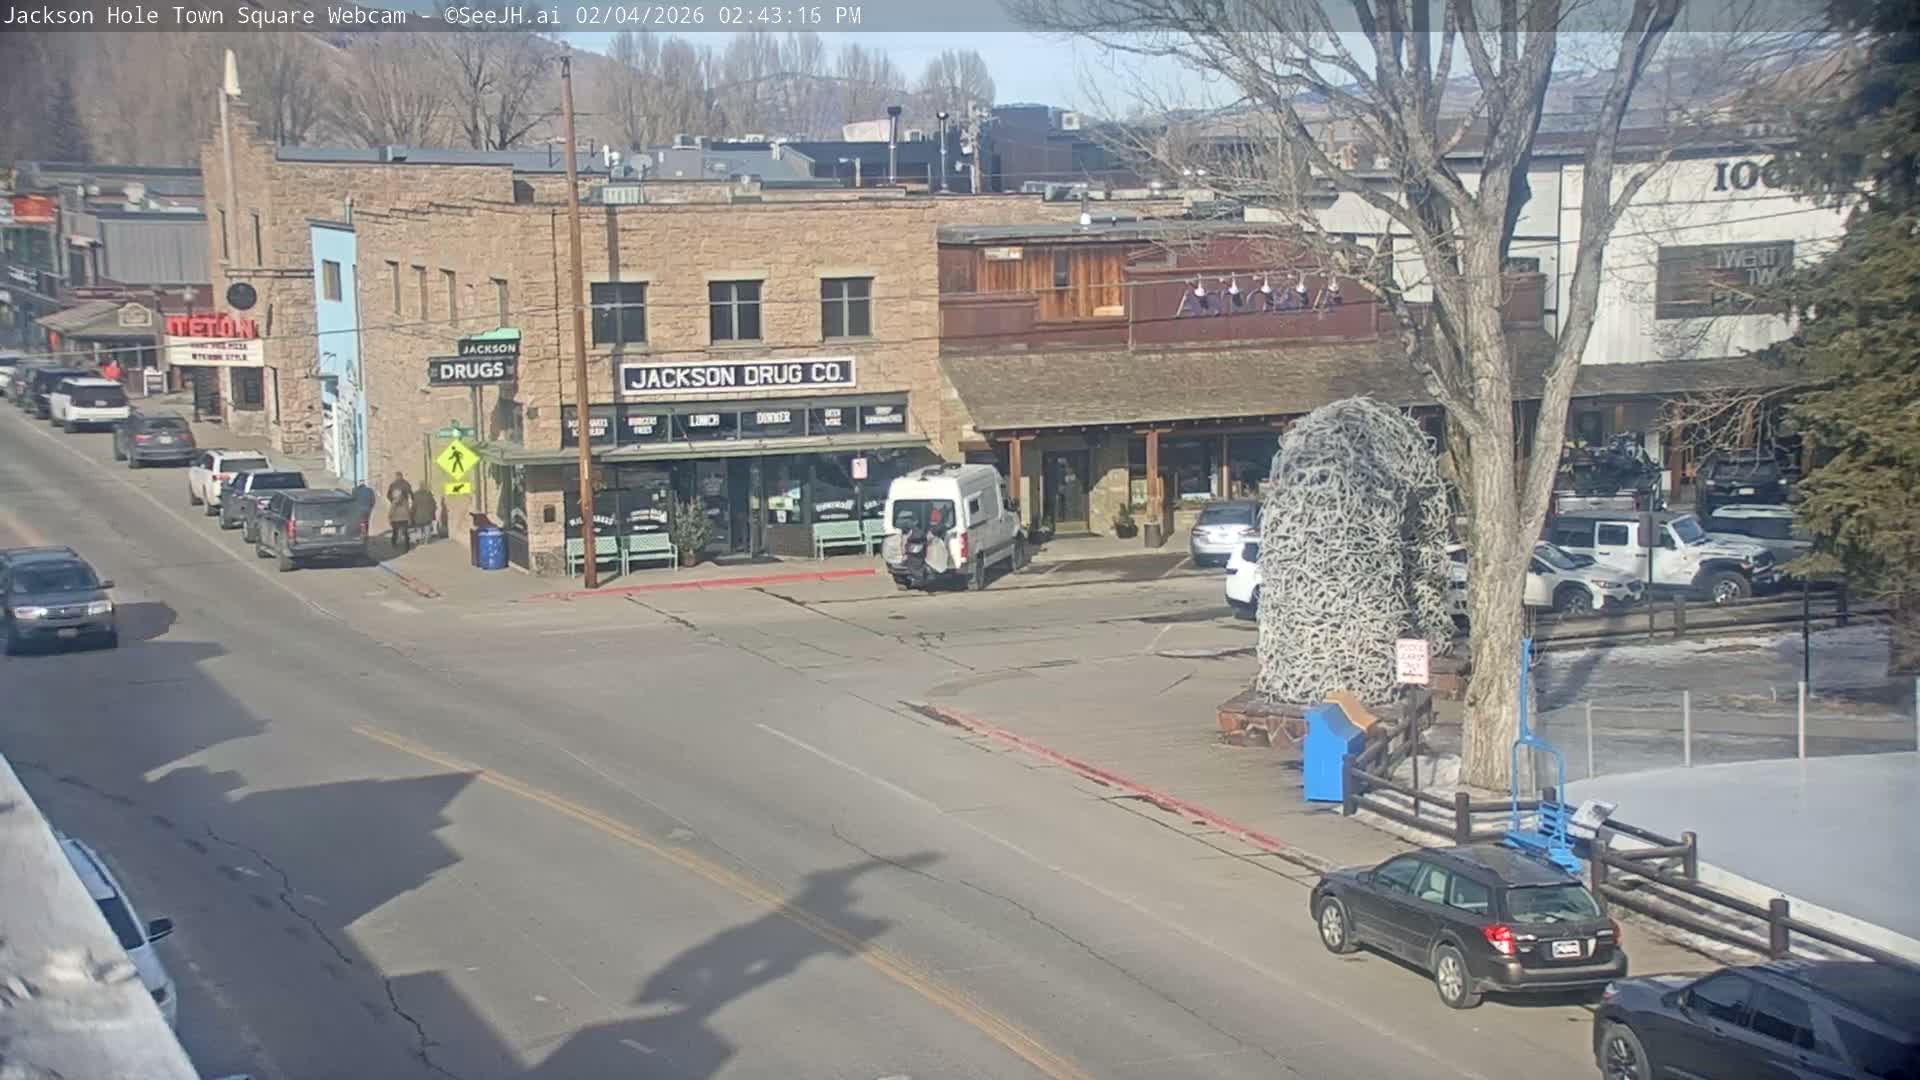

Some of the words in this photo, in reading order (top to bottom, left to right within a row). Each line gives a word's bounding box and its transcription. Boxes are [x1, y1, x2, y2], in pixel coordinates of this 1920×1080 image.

[166, 316, 256, 338] TETON
[463, 343, 517, 355] JACKSON
[439, 361, 505, 380] DRUGS
[631, 366, 736, 389] JACKSON
[743, 364, 803, 385] DRUG
[810, 363, 845, 382] CO.
[688, 413, 720, 427] LUNCH
[756, 410, 791, 424] DINNER
